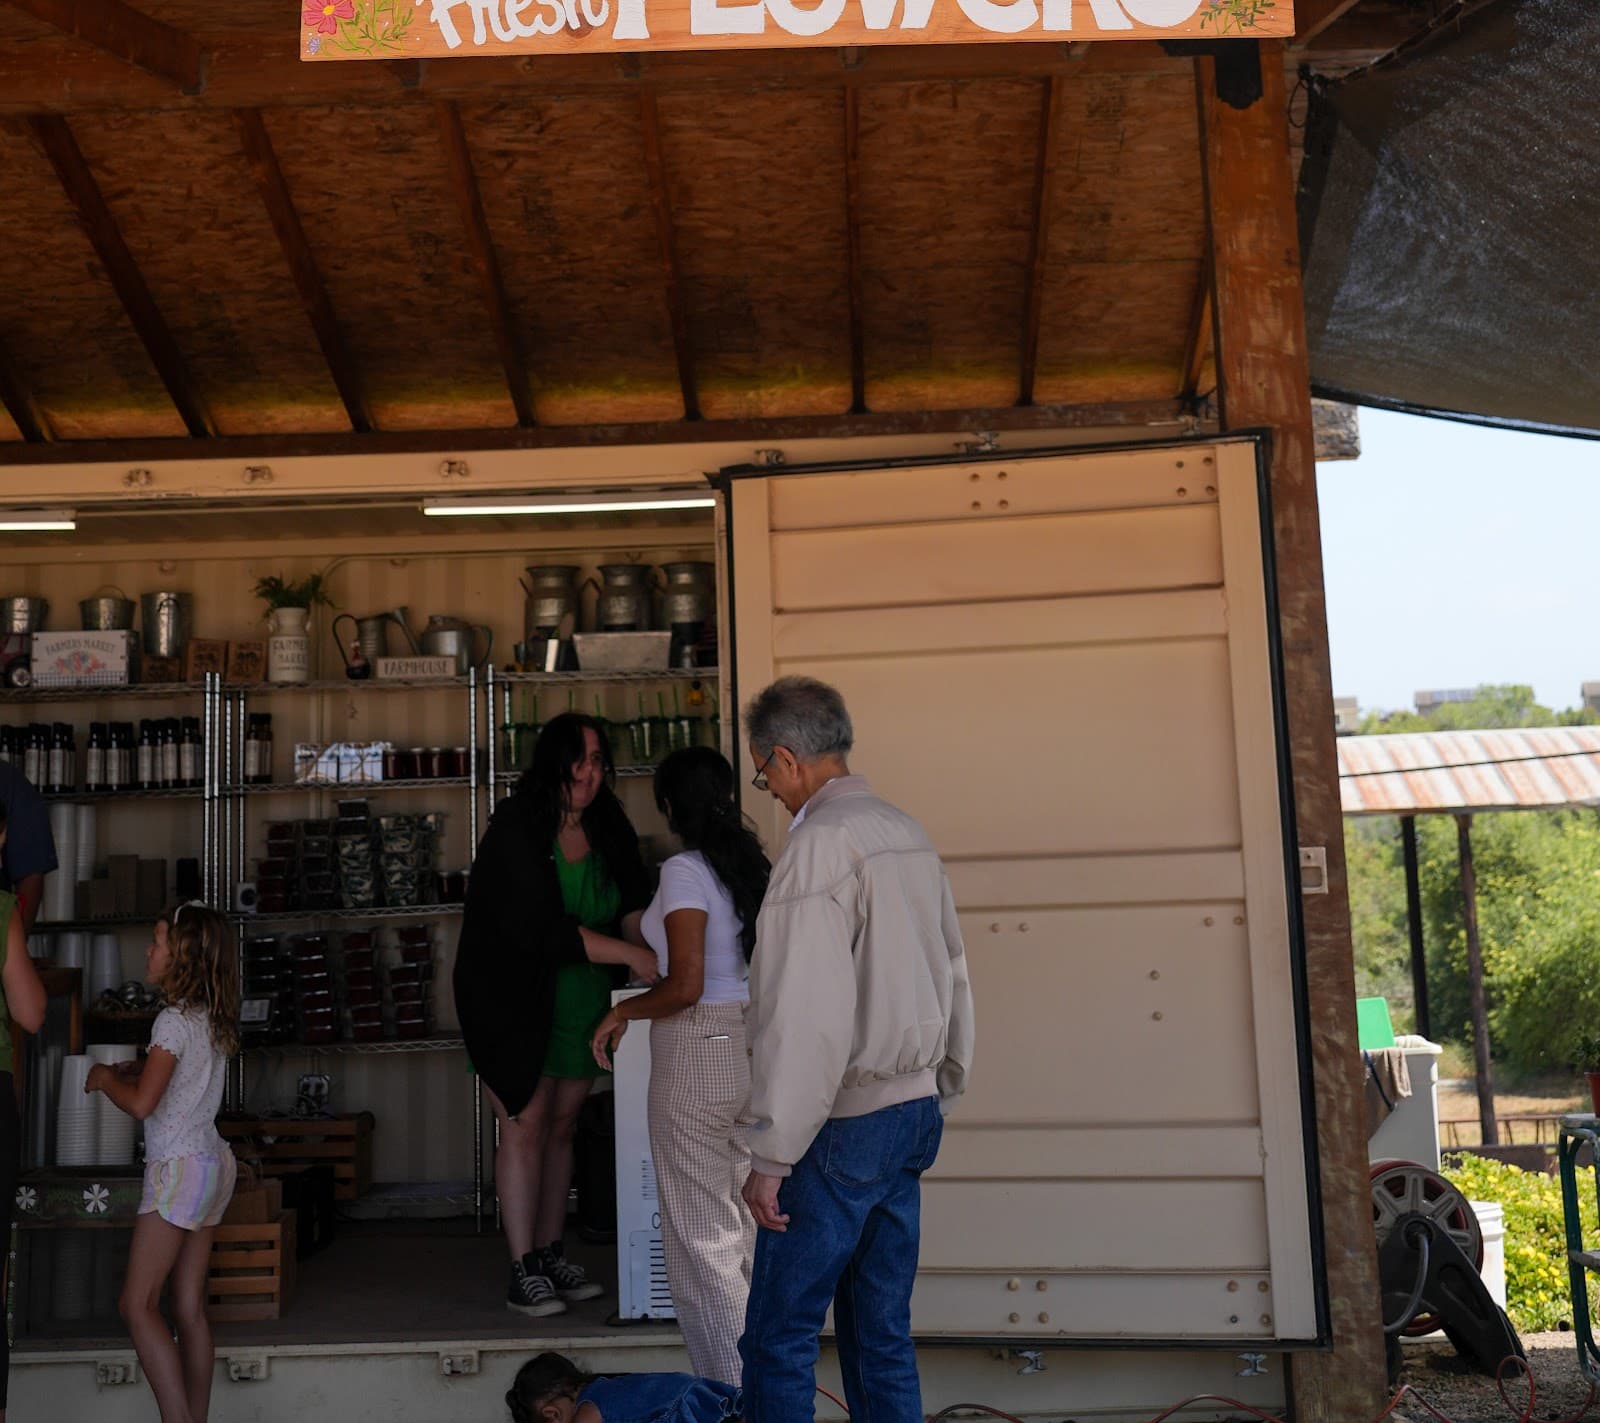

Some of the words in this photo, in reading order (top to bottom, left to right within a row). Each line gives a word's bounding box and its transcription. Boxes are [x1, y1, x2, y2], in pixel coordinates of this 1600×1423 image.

[45, 639, 82, 656] FARMERS
[83, 639, 116, 655] MARKET
[272, 639, 305, 651] FARME
[383, 660, 449, 676] FARMHOUSE
